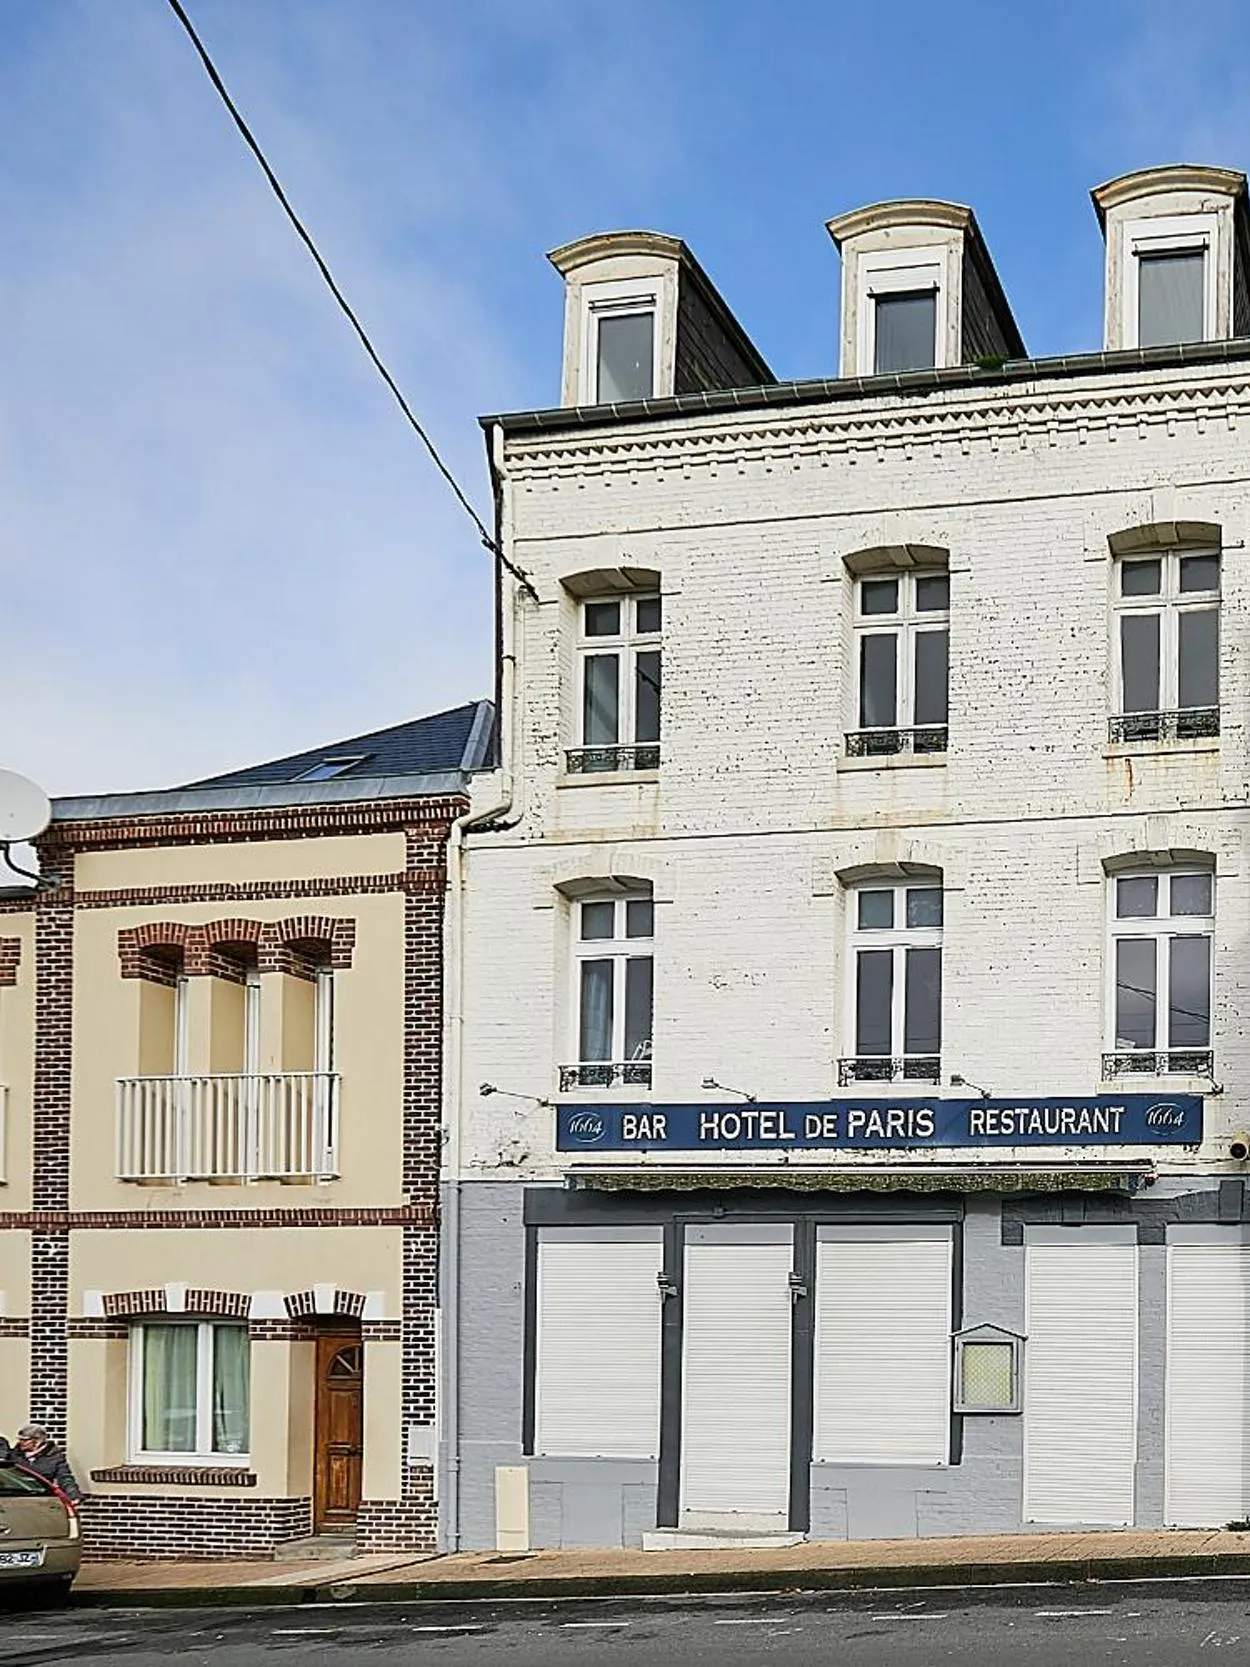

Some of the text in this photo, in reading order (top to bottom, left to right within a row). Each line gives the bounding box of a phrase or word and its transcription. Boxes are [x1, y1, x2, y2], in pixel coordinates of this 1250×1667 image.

[622, 1106, 1125, 1140] BAR HOTEL DE PARIS RESTAURANT
